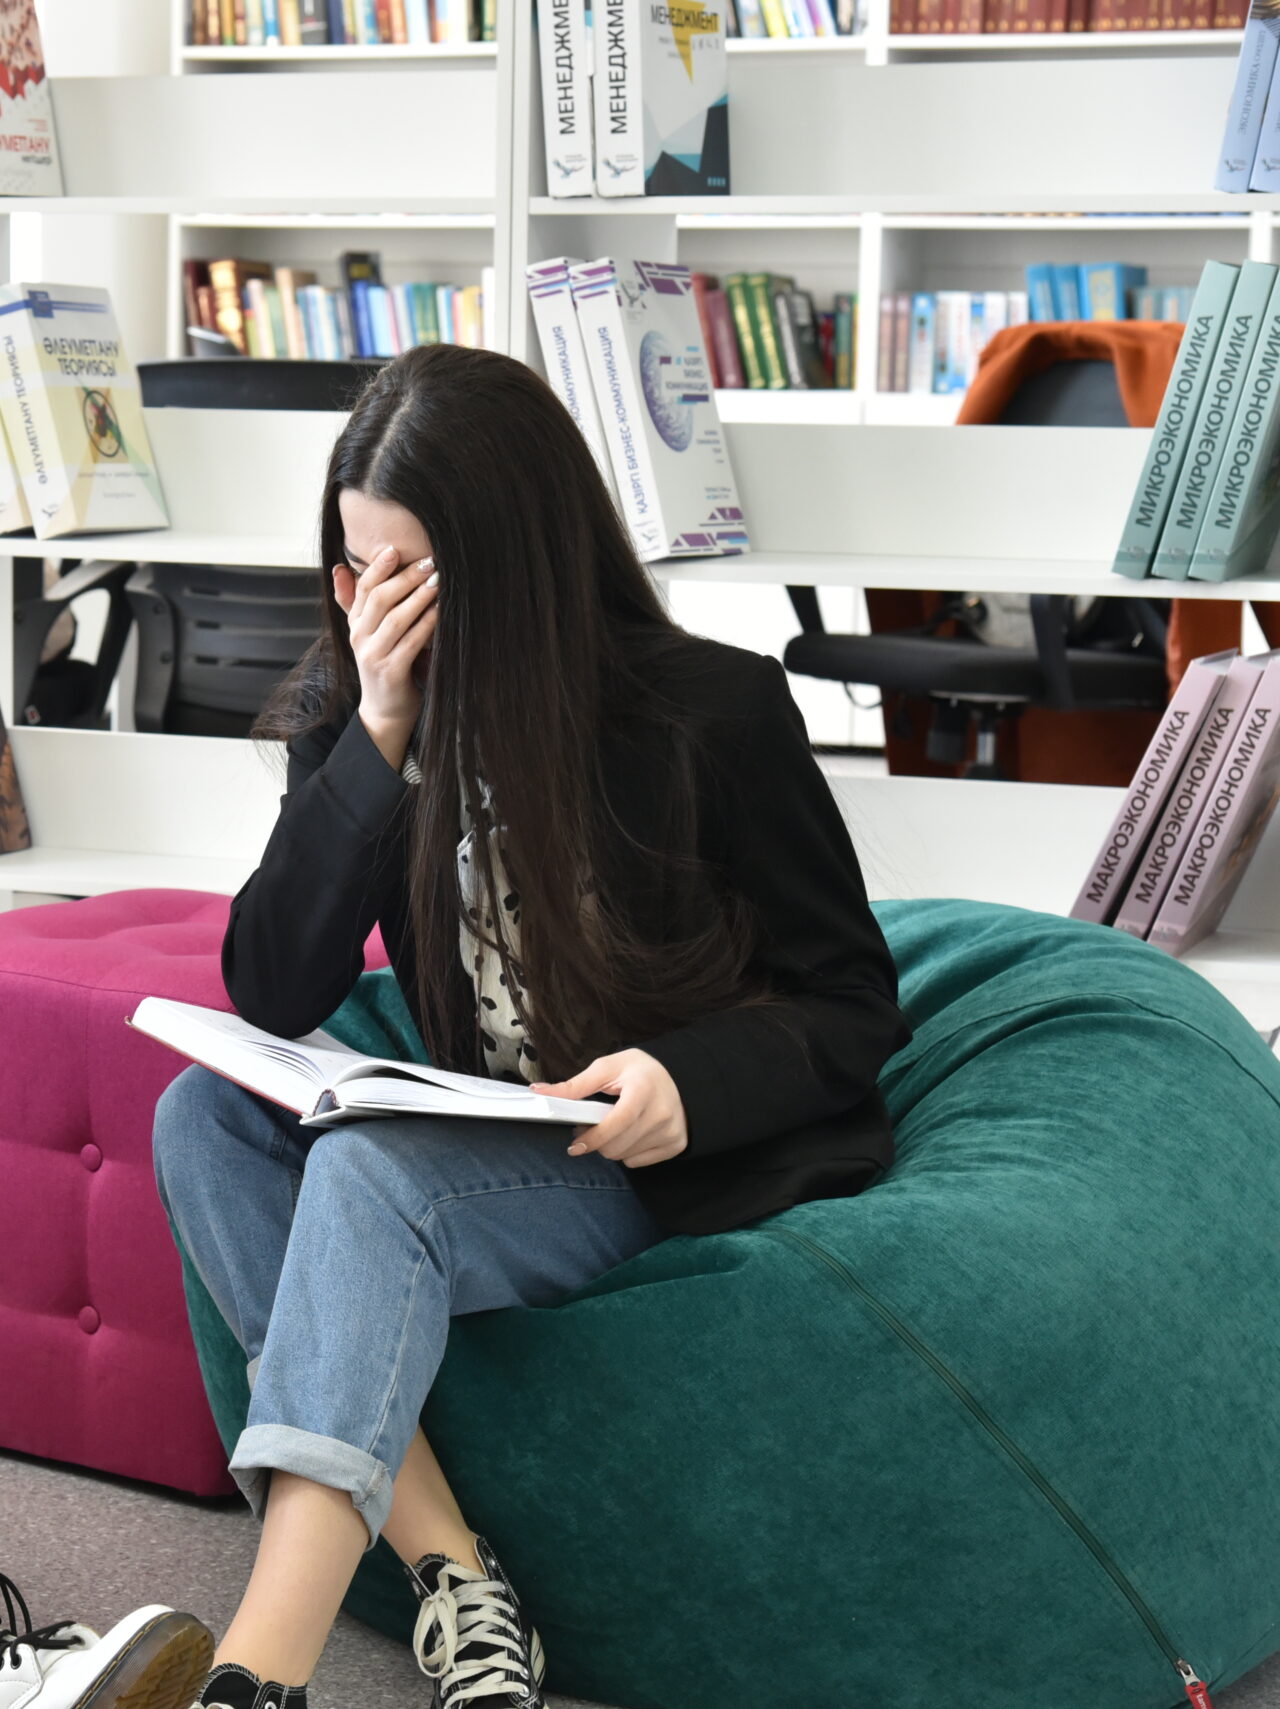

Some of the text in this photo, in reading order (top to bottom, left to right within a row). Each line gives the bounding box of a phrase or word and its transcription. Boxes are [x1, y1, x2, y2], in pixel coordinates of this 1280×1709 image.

[651, 4, 720, 34] МЕНЕДЖМЕНТ
[1238, 63, 1262, 136] ЭКОНОМИКА
[2, 335, 27, 403] ТЕОРИЯСЫ
[43, 337, 119, 357] ӘЛЕУМЕТТАНУ
[58, 357, 117, 377] ТЕОРИЯСЫ
[597, 326, 648, 514] ҚАЗІРГІ БИЗНЕС-КОММУНИКАЦИЯ
[1135, 315, 1214, 528] МИКРОЭКОНОМИКА
[1176, 315, 1253, 530] МИКРОЭКОНОМИКА
[1086, 708, 1190, 904] МАКРОЭКОНОМИКА
[1135, 706, 1234, 904] МАКРОЭКОНОМИКА
[1174, 706, 1271, 906] МАКРОЭКОНОМИКА
